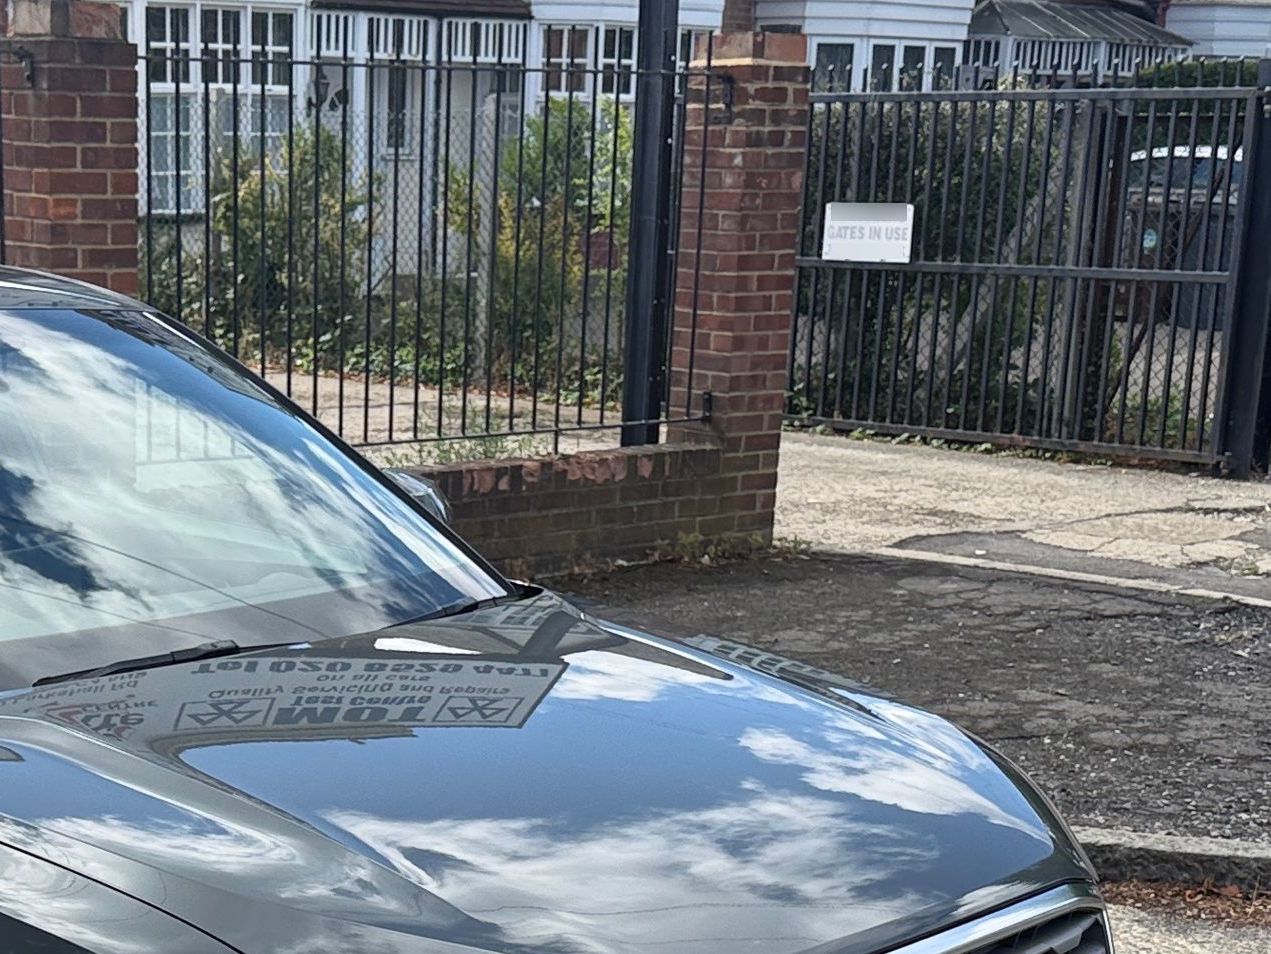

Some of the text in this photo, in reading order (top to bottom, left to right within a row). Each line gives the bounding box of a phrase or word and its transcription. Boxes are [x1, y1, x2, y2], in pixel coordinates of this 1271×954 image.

[827, 225, 908, 241] GATES IN USE
